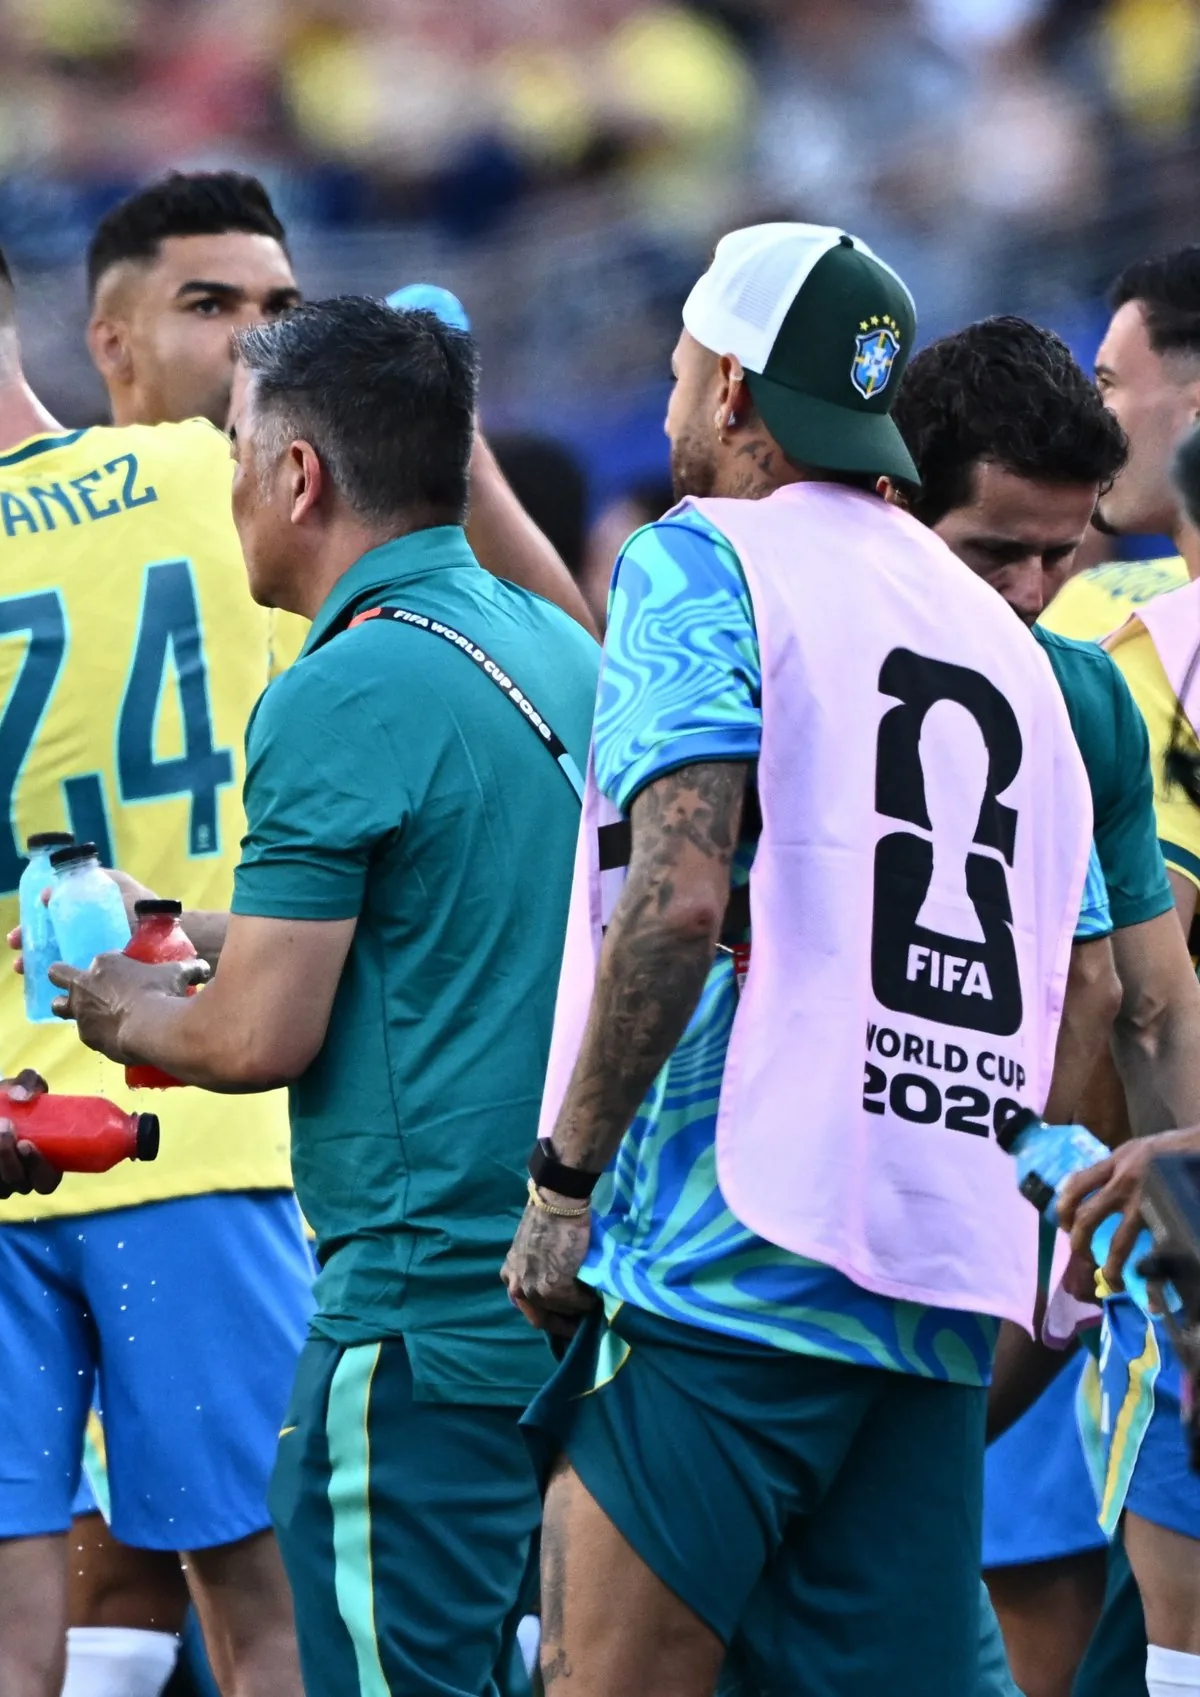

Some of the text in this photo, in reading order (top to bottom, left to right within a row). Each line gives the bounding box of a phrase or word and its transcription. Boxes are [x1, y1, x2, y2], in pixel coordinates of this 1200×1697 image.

[393, 610, 429, 628] FIFA
[430, 621, 485, 662] WORLD
[484, 660, 512, 689] CUP
[906, 943, 994, 1001] FIFA
[975, 1050, 1026, 1092] CUP
